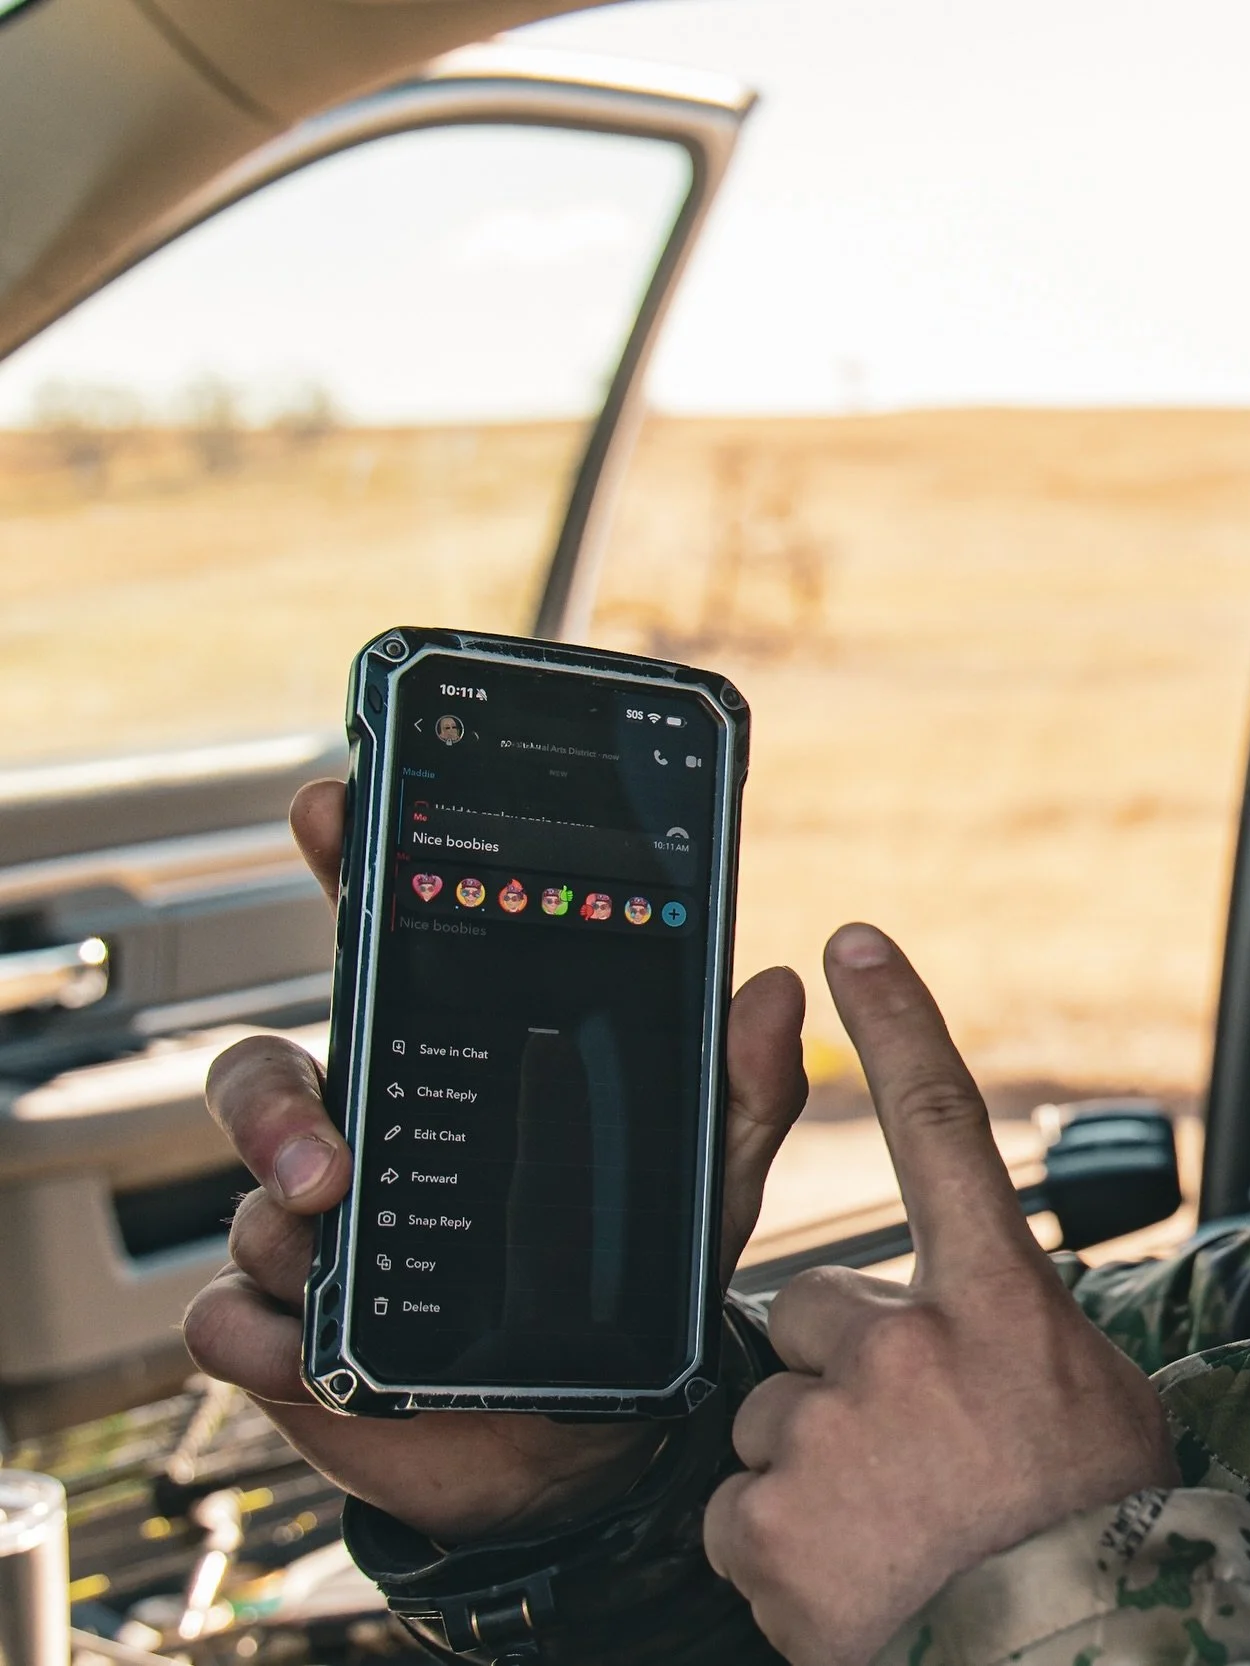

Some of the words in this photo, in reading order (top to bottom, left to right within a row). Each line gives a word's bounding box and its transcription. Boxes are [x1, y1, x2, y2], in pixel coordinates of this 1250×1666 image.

[439, 683, 473, 699] 10:11
[625, 708, 644, 721] SOS
[402, 767, 436, 779] Maddie
[413, 812, 428, 822] Me
[412, 831, 442, 847] Nice
[446, 834, 500, 853] boobies
[653, 840, 675, 851] 10:11
[676, 843, 690, 853] AM
[399, 916, 430, 931] Nice
[432, 918, 487, 936] boobies
[419, 1043, 447, 1056] Save
[449, 1046, 460, 1057] in
[462, 1047, 489, 1060] Chat
[416, 1086, 444, 1099] Chat
[446, 1088, 478, 1104] Reply
[413, 1128, 437, 1141] Edit
[439, 1130, 466, 1143] Chat
[411, 1171, 458, 1185] Forward
[408, 1214, 438, 1229] Snap
[440, 1216, 472, 1231] Reply
[405, 1257, 436, 1273] Copy
[402, 1300, 441, 1313] Delete
